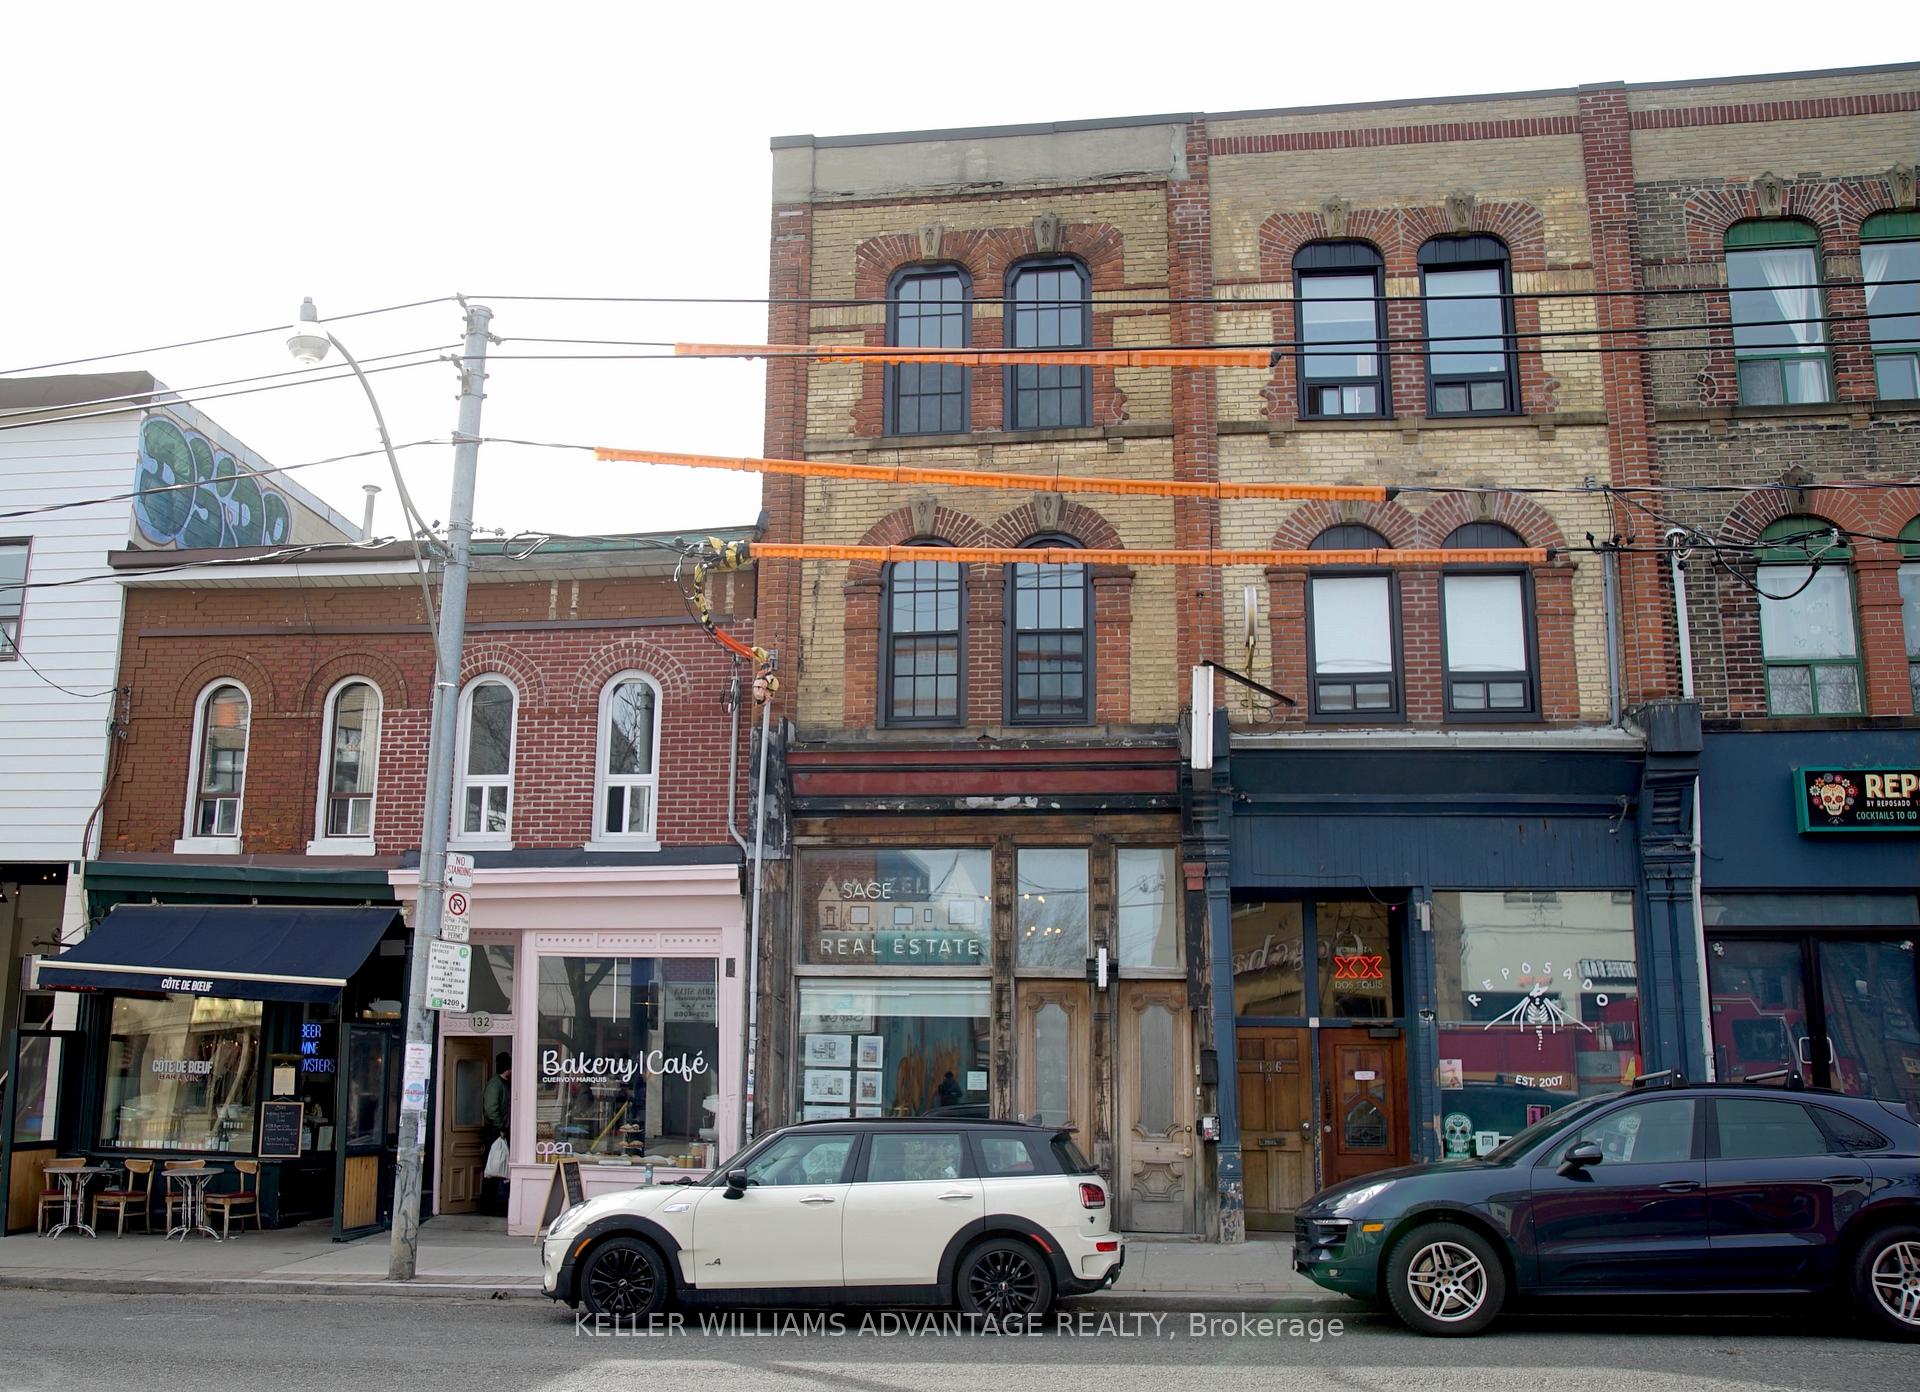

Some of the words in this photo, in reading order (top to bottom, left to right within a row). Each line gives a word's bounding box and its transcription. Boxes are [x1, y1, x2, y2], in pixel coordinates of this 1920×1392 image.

[1865, 773, 1920, 798] REP
[1856, 811, 1894, 820] COCKTAILS
[1897, 811, 1905, 820] TO
[1907, 811, 1917, 820] GO
[455, 856, 466, 866] NO
[447, 864, 472, 877] STANDING
[843, 882, 892, 899] SAGE
[444, 923, 460, 933] EXCEPT
[820, 938, 883, 955] REAL
[894, 938, 979, 955] ESTATE
[1334, 956, 1384, 979] XX
[161, 976, 180, 990] CÔTE
[181, 980, 191, 991] DE
[1468, 962, 1608, 1007] REPOSADO
[442, 998, 460, 1006] 4209
[472, 1017, 490, 1027] 132
[301, 1023, 321, 1038] BEER
[152, 1056, 175, 1073] CÔTE
[176, 1060, 187, 1073] DE
[542, 1050, 637, 1083] Bakery
[646, 1050, 708, 1083] Café
[1259, 1061, 1282, 1072] 136
[1515, 1074, 1536, 1087] EST.
[1539, 1075, 1563, 1088] 2007
[536, 1141, 572, 1163] open
